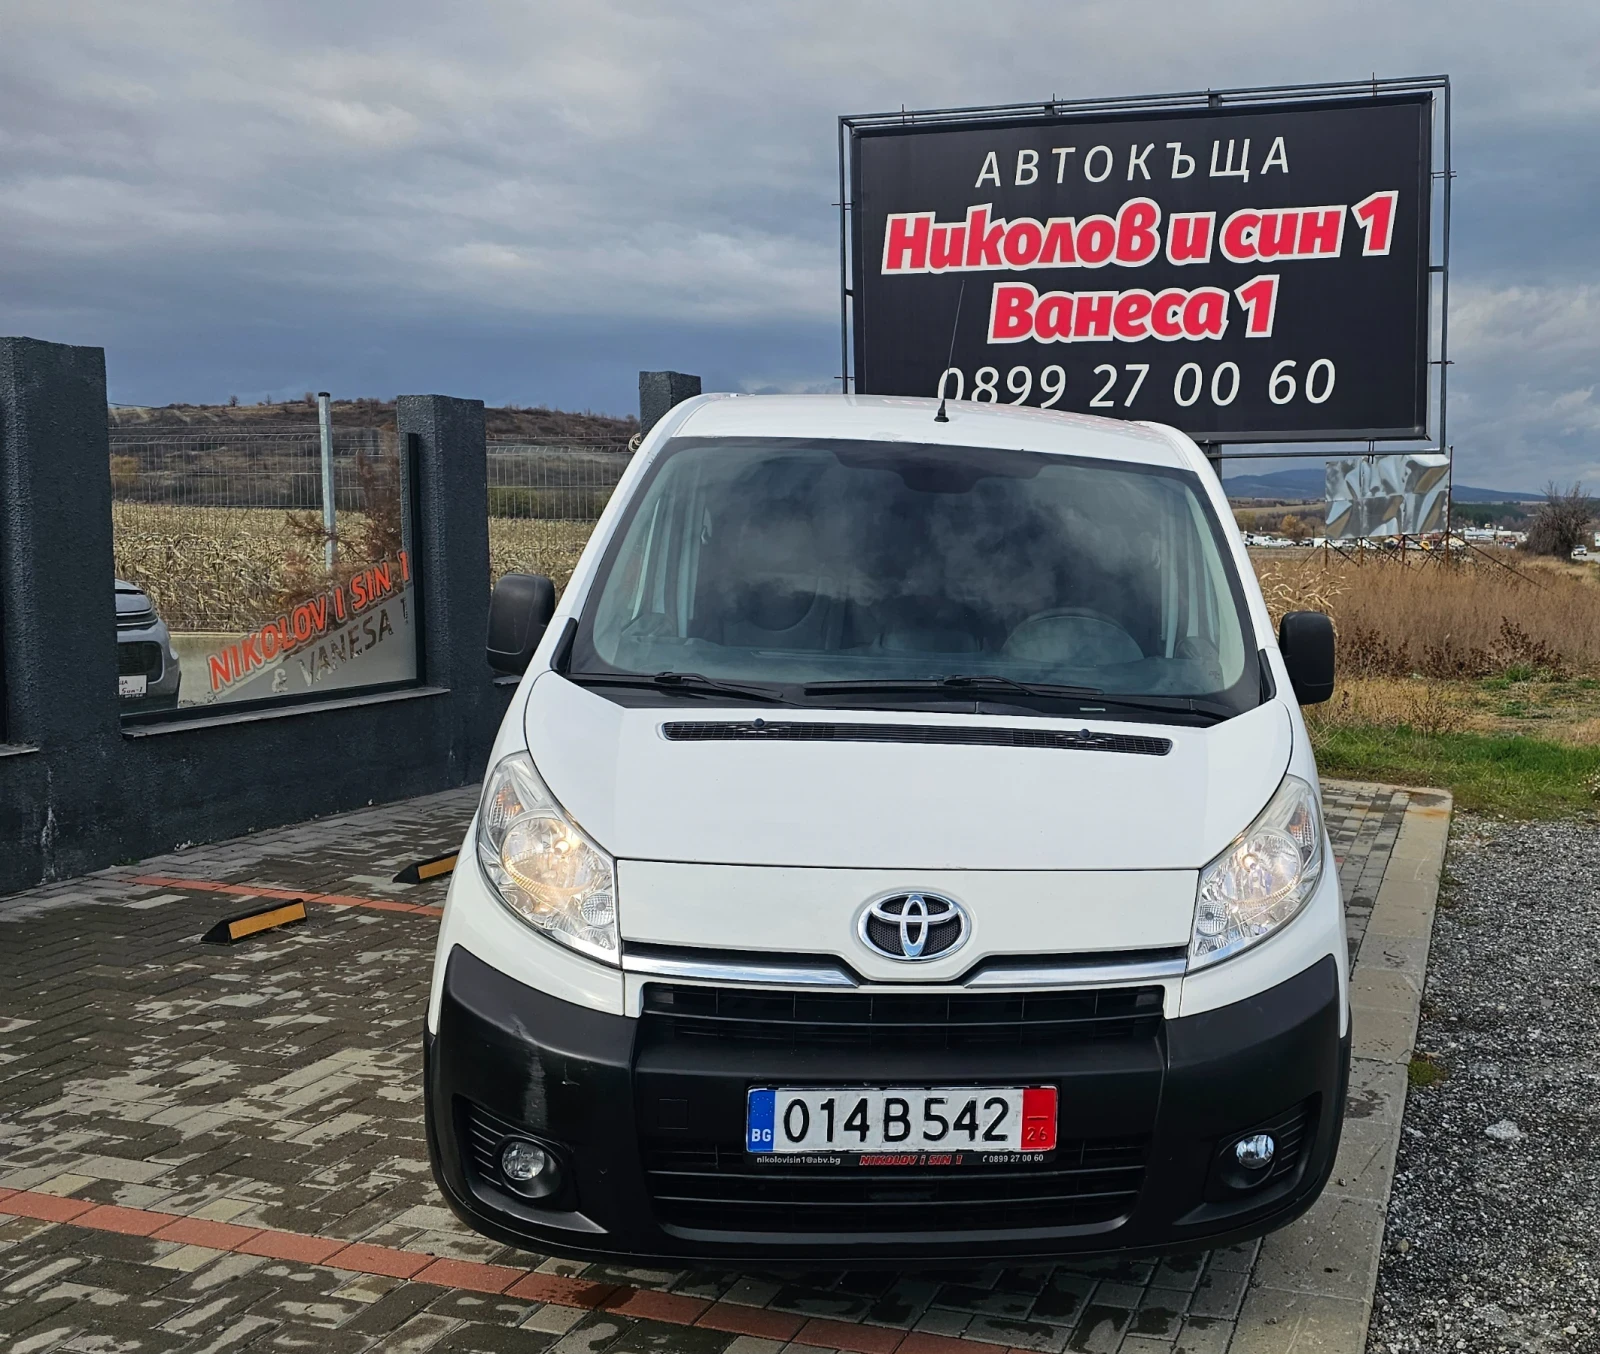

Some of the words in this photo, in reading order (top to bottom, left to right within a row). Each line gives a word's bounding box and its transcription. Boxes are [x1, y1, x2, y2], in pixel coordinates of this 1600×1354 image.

[976, 136, 1289, 188] АВТОКЪЩА
[881, 196, 1161, 275] Николов
[1166, 211, 1217, 264] и
[1220, 204, 1347, 262] син
[1351, 190, 1398, 256] 1
[987, 281, 1230, 344] Ванеса
[1236, 274, 1280, 338] 1
[937, 364, 1067, 409] 0899
[1090, 363, 1150, 407] 27
[1174, 361, 1240, 406] 00
[1268, 358, 1336, 404] 60
[206, 593, 328, 693] NIKOLOV
[349, 559, 393, 613] SIN
[397, 549, 410, 582] 1
[751, 1128, 772, 1142] BG
[1026, 1126, 1049, 1142] 26
[756, 1155, 841, 1166] nikolovisin1@abv.bg
[859, 1154, 918, 1166] NIKOLOV
[928, 1154, 951, 1165] SIN
[955, 1154, 963, 1165] 1
[988, 1154, 1009, 1163] 0899
[1010, 1154, 1020, 1163] 27
[1022, 1154, 1032, 1163] 00
[1034, 1153, 1044, 1162] 60
